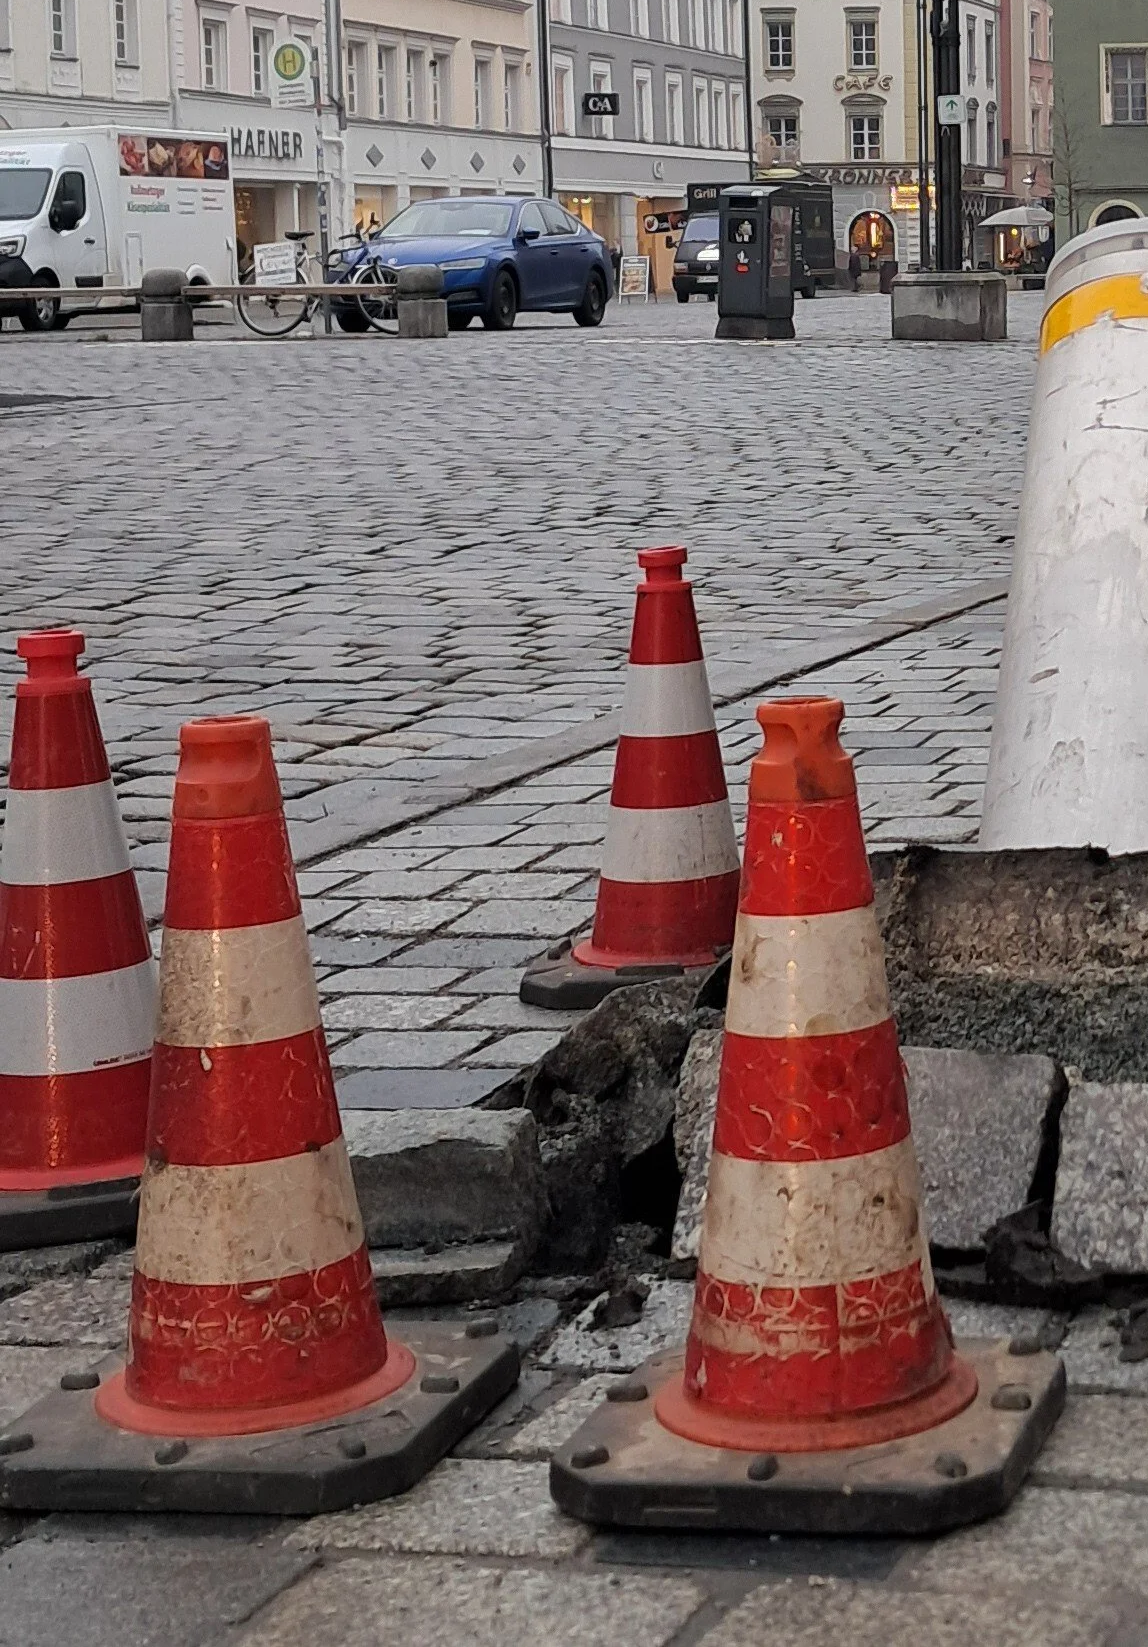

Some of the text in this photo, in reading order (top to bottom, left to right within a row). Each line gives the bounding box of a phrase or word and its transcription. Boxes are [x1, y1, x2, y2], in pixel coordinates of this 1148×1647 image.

[282, 50, 297, 73] H
[588, 97, 613, 112] C&A
[693, 188, 717, 199] Grill
